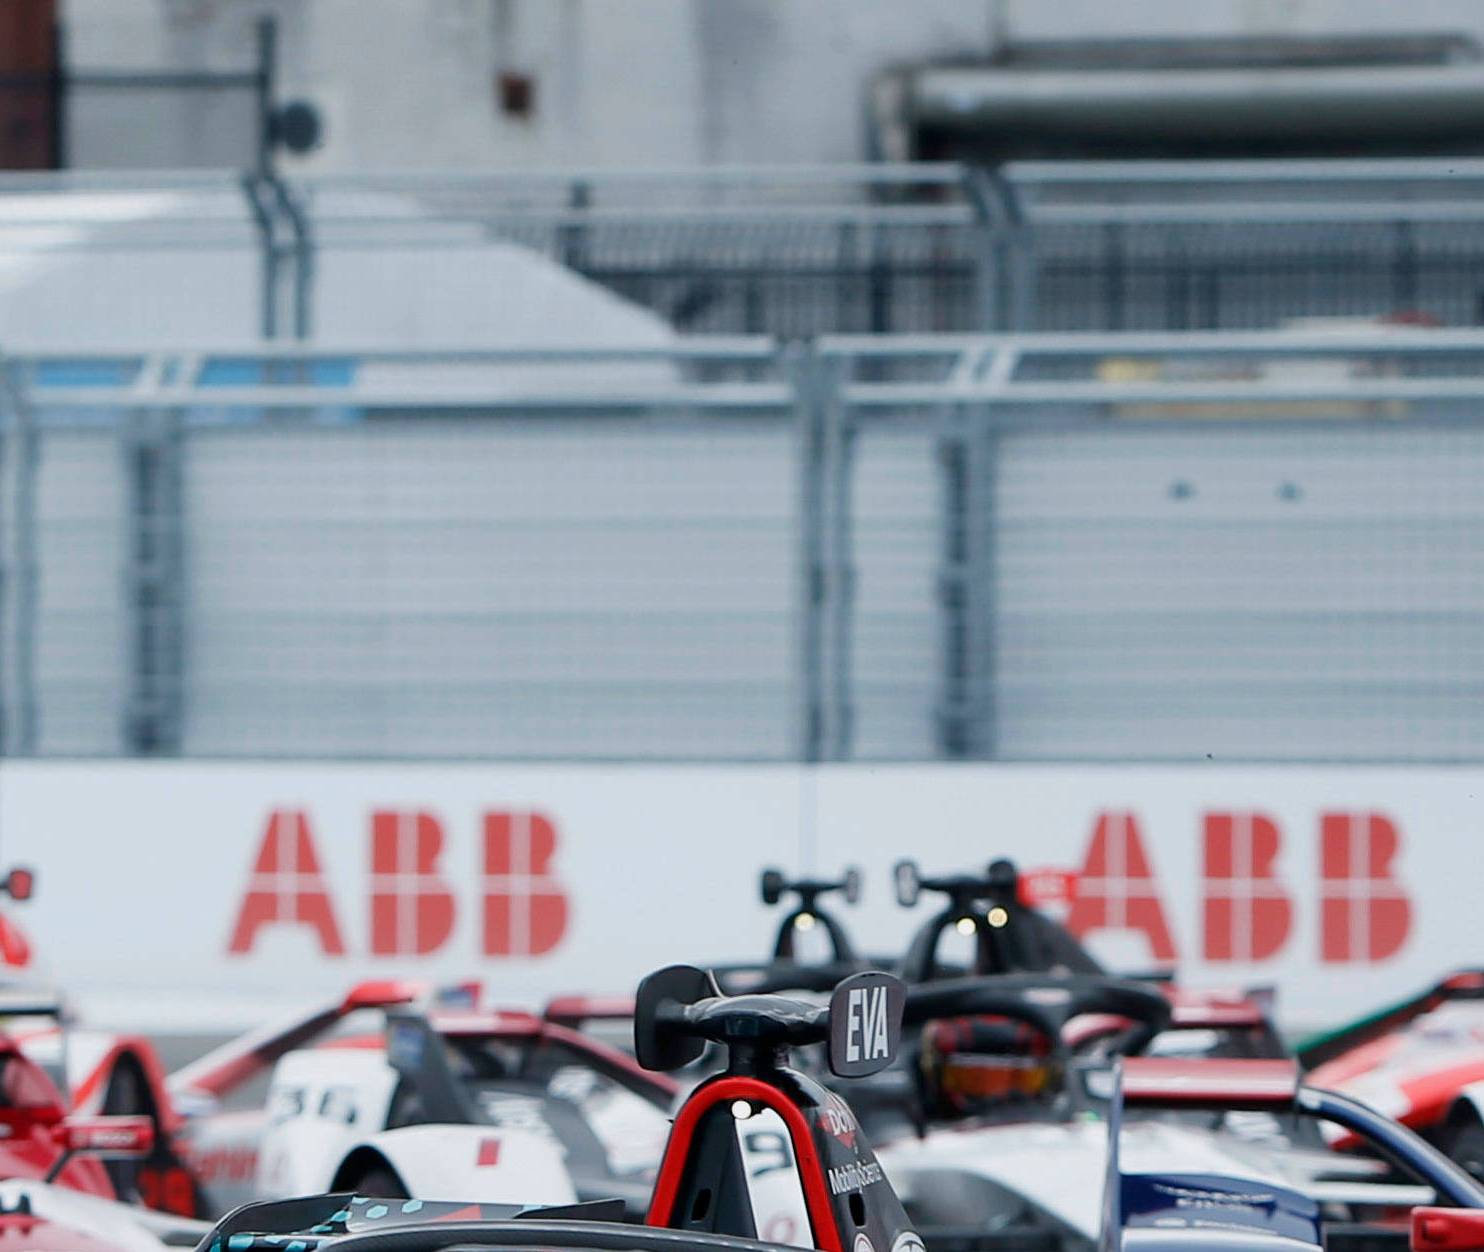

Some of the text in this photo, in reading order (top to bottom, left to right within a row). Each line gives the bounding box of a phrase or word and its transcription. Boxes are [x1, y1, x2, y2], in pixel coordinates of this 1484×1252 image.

[227, 810, 572, 958] ABB
[1064, 812, 1414, 964] ABB
[846, 986, 890, 1063] EVA
